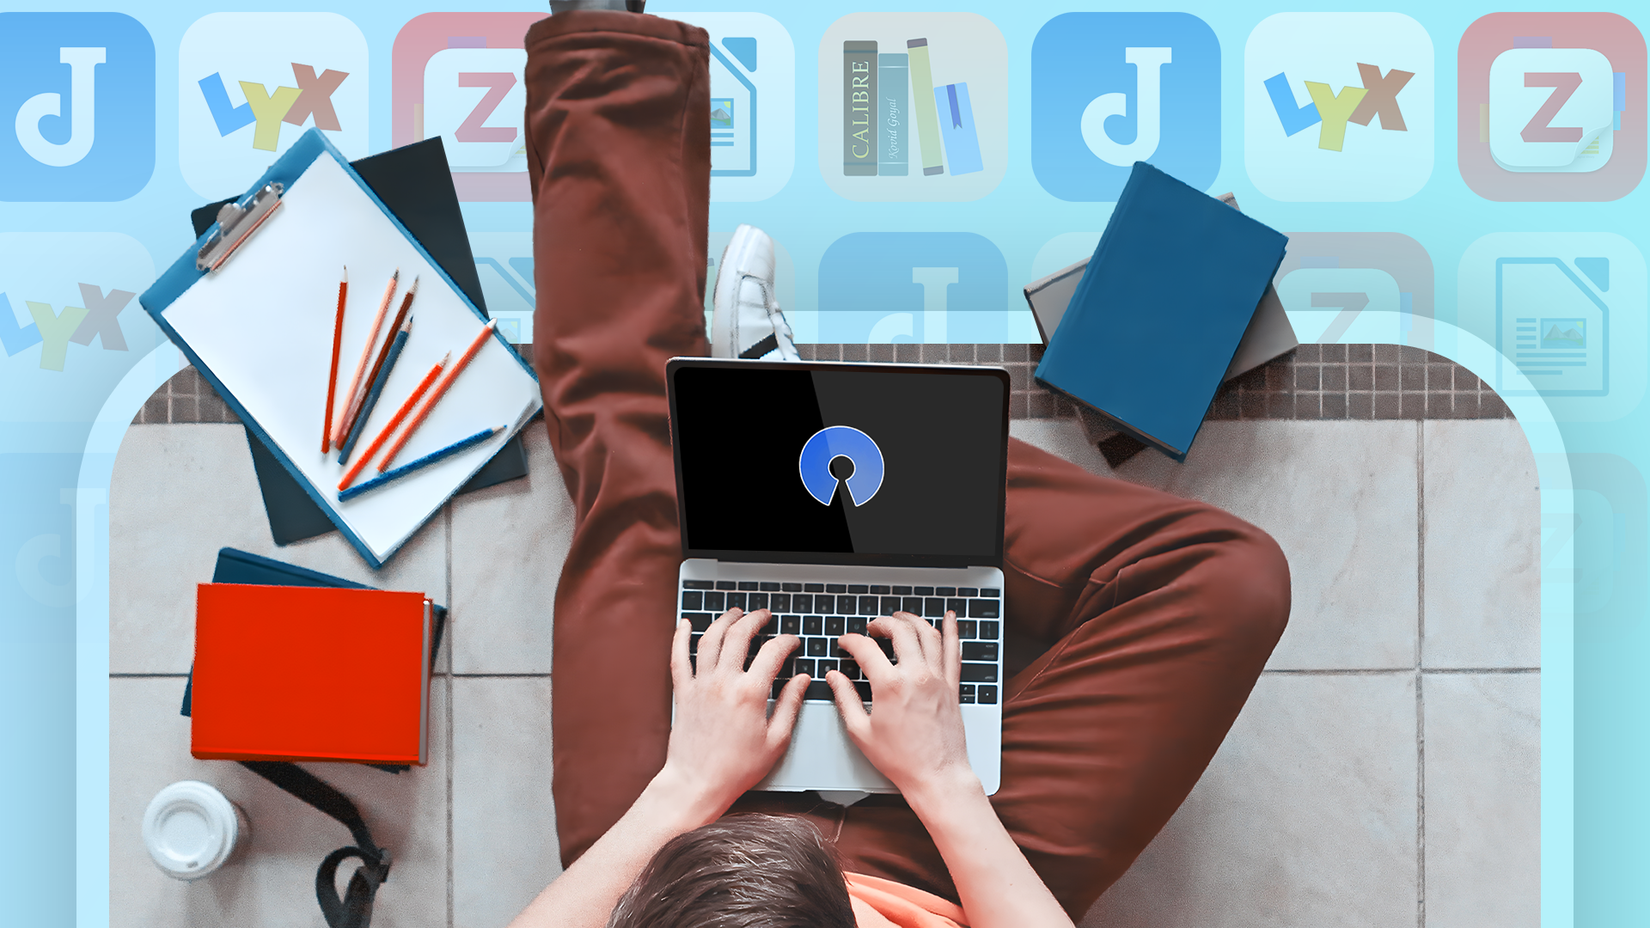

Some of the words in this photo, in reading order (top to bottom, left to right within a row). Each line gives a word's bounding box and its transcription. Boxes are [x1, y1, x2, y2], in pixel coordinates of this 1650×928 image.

[15, 47, 106, 167] J
[454, 72, 517, 142] Z
[852, 61, 869, 159] CALIBRE
[885, 97, 900, 127] Goyal
[1081, 47, 1172, 167] J
[1519, 72, 1583, 142] Z
[886, 128, 900, 159] Kovid
